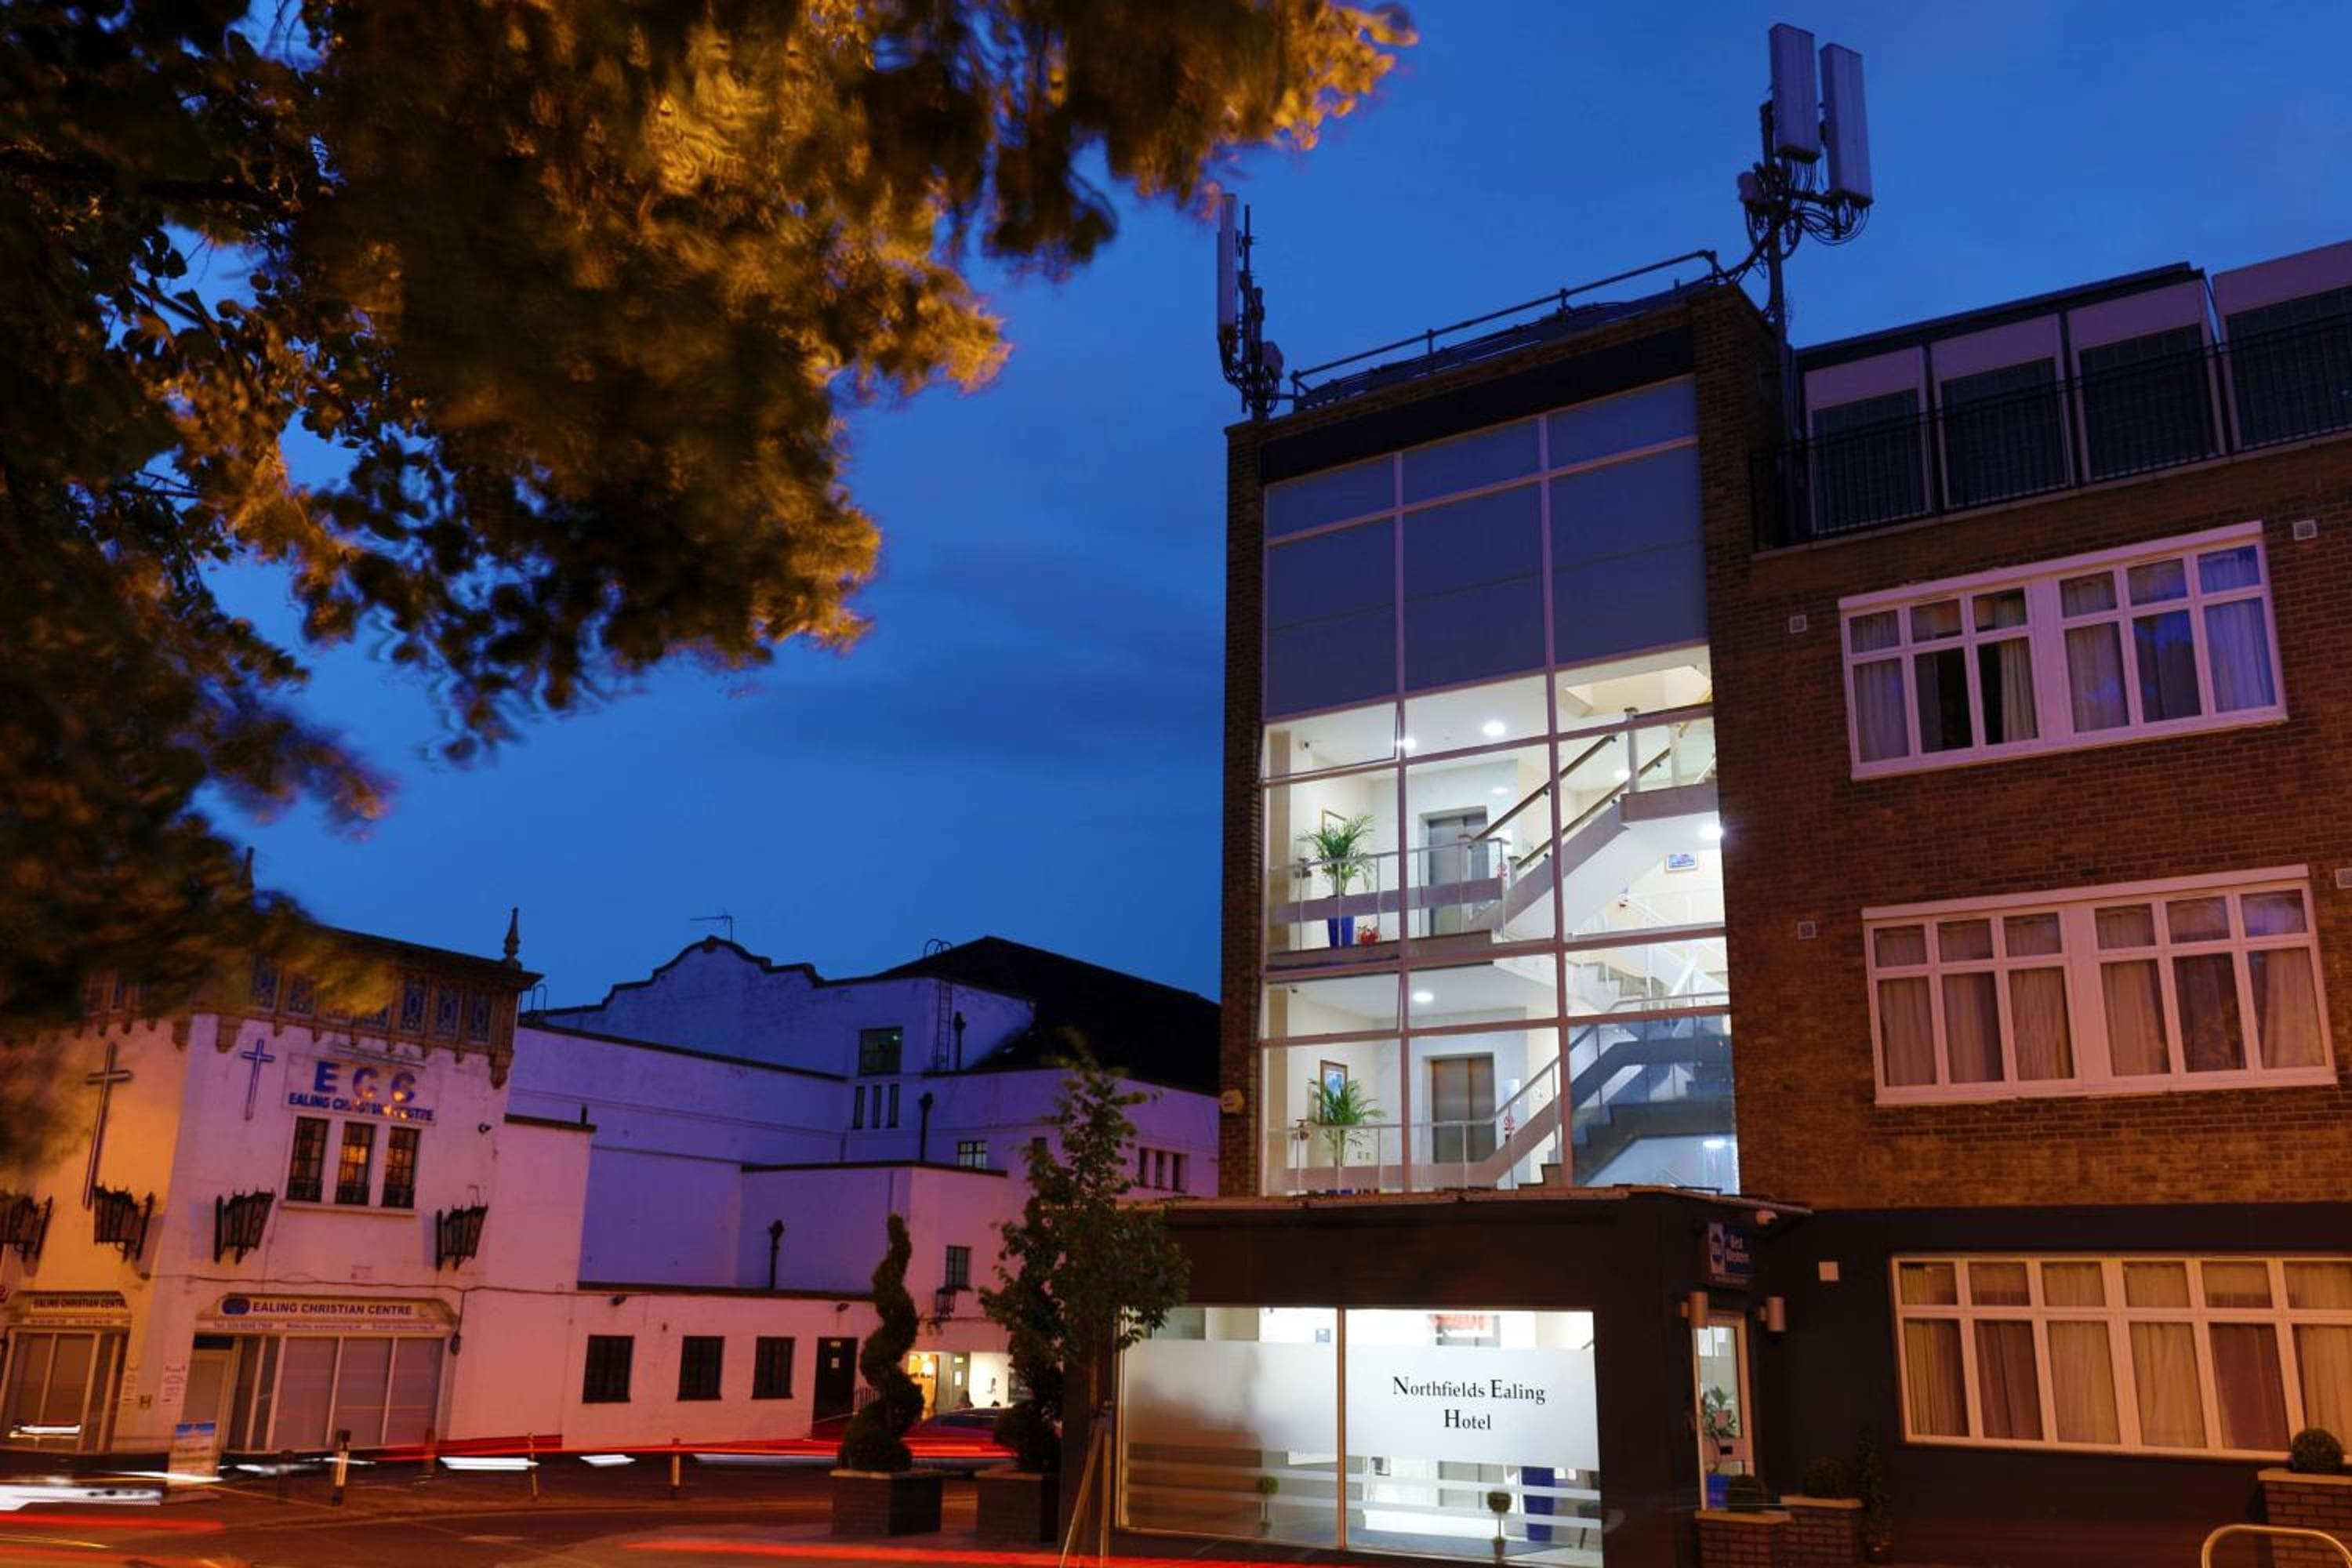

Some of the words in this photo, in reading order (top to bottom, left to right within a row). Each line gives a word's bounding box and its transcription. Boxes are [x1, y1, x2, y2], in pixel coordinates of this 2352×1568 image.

[289, 1092, 330, 1109] EALING
[252, 1302, 297, 1314] EALING
[300, 1303, 365, 1315] CHRISTIAN
[367, 1305, 412, 1316] CENTRE
[1392, 1376, 1486, 1398] Northfields
[1490, 1379, 1545, 1405] Ealing
[1443, 1409, 1491, 1430] Hotel
